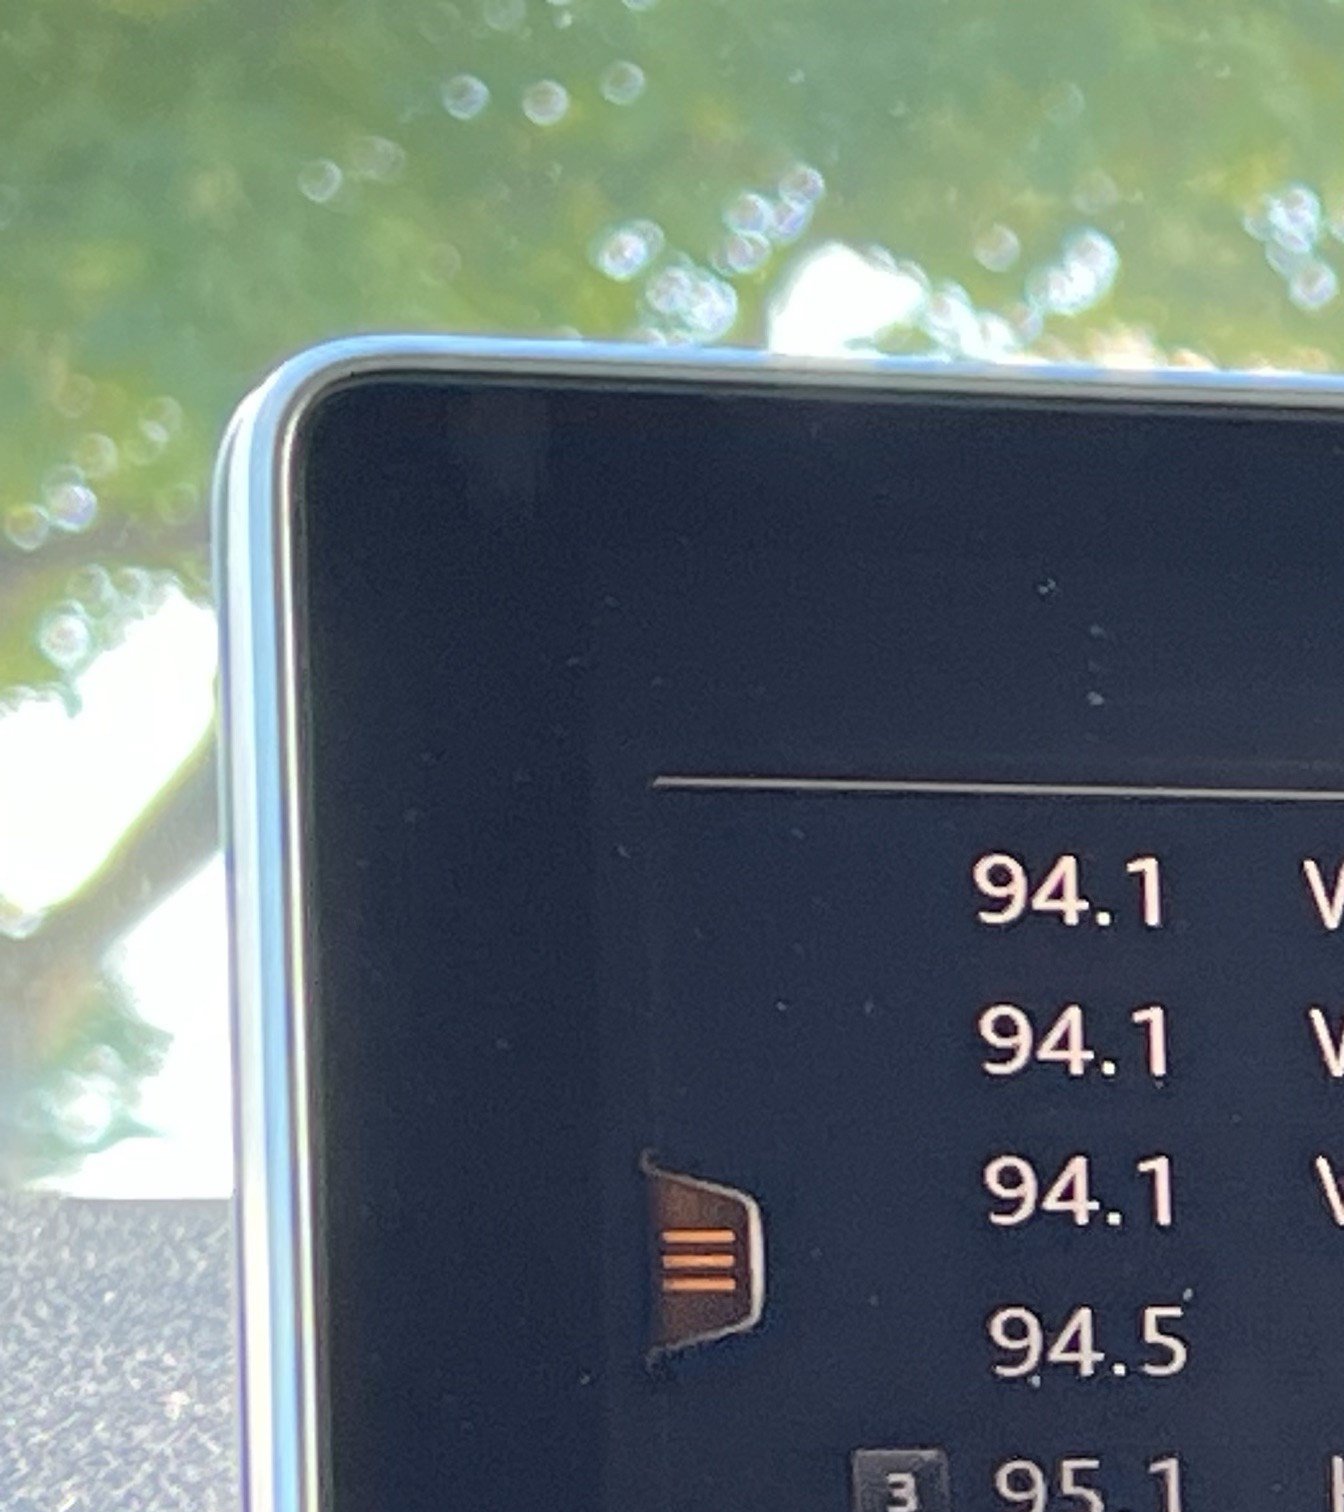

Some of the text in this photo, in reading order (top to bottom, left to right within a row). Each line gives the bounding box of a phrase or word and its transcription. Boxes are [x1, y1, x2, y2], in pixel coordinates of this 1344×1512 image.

[974, 856, 1164, 928] 94.1
[979, 1006, 1170, 1077] 94.1
[985, 1156, 1177, 1227] 94.1
[989, 1306, 1188, 1377] 94.5
